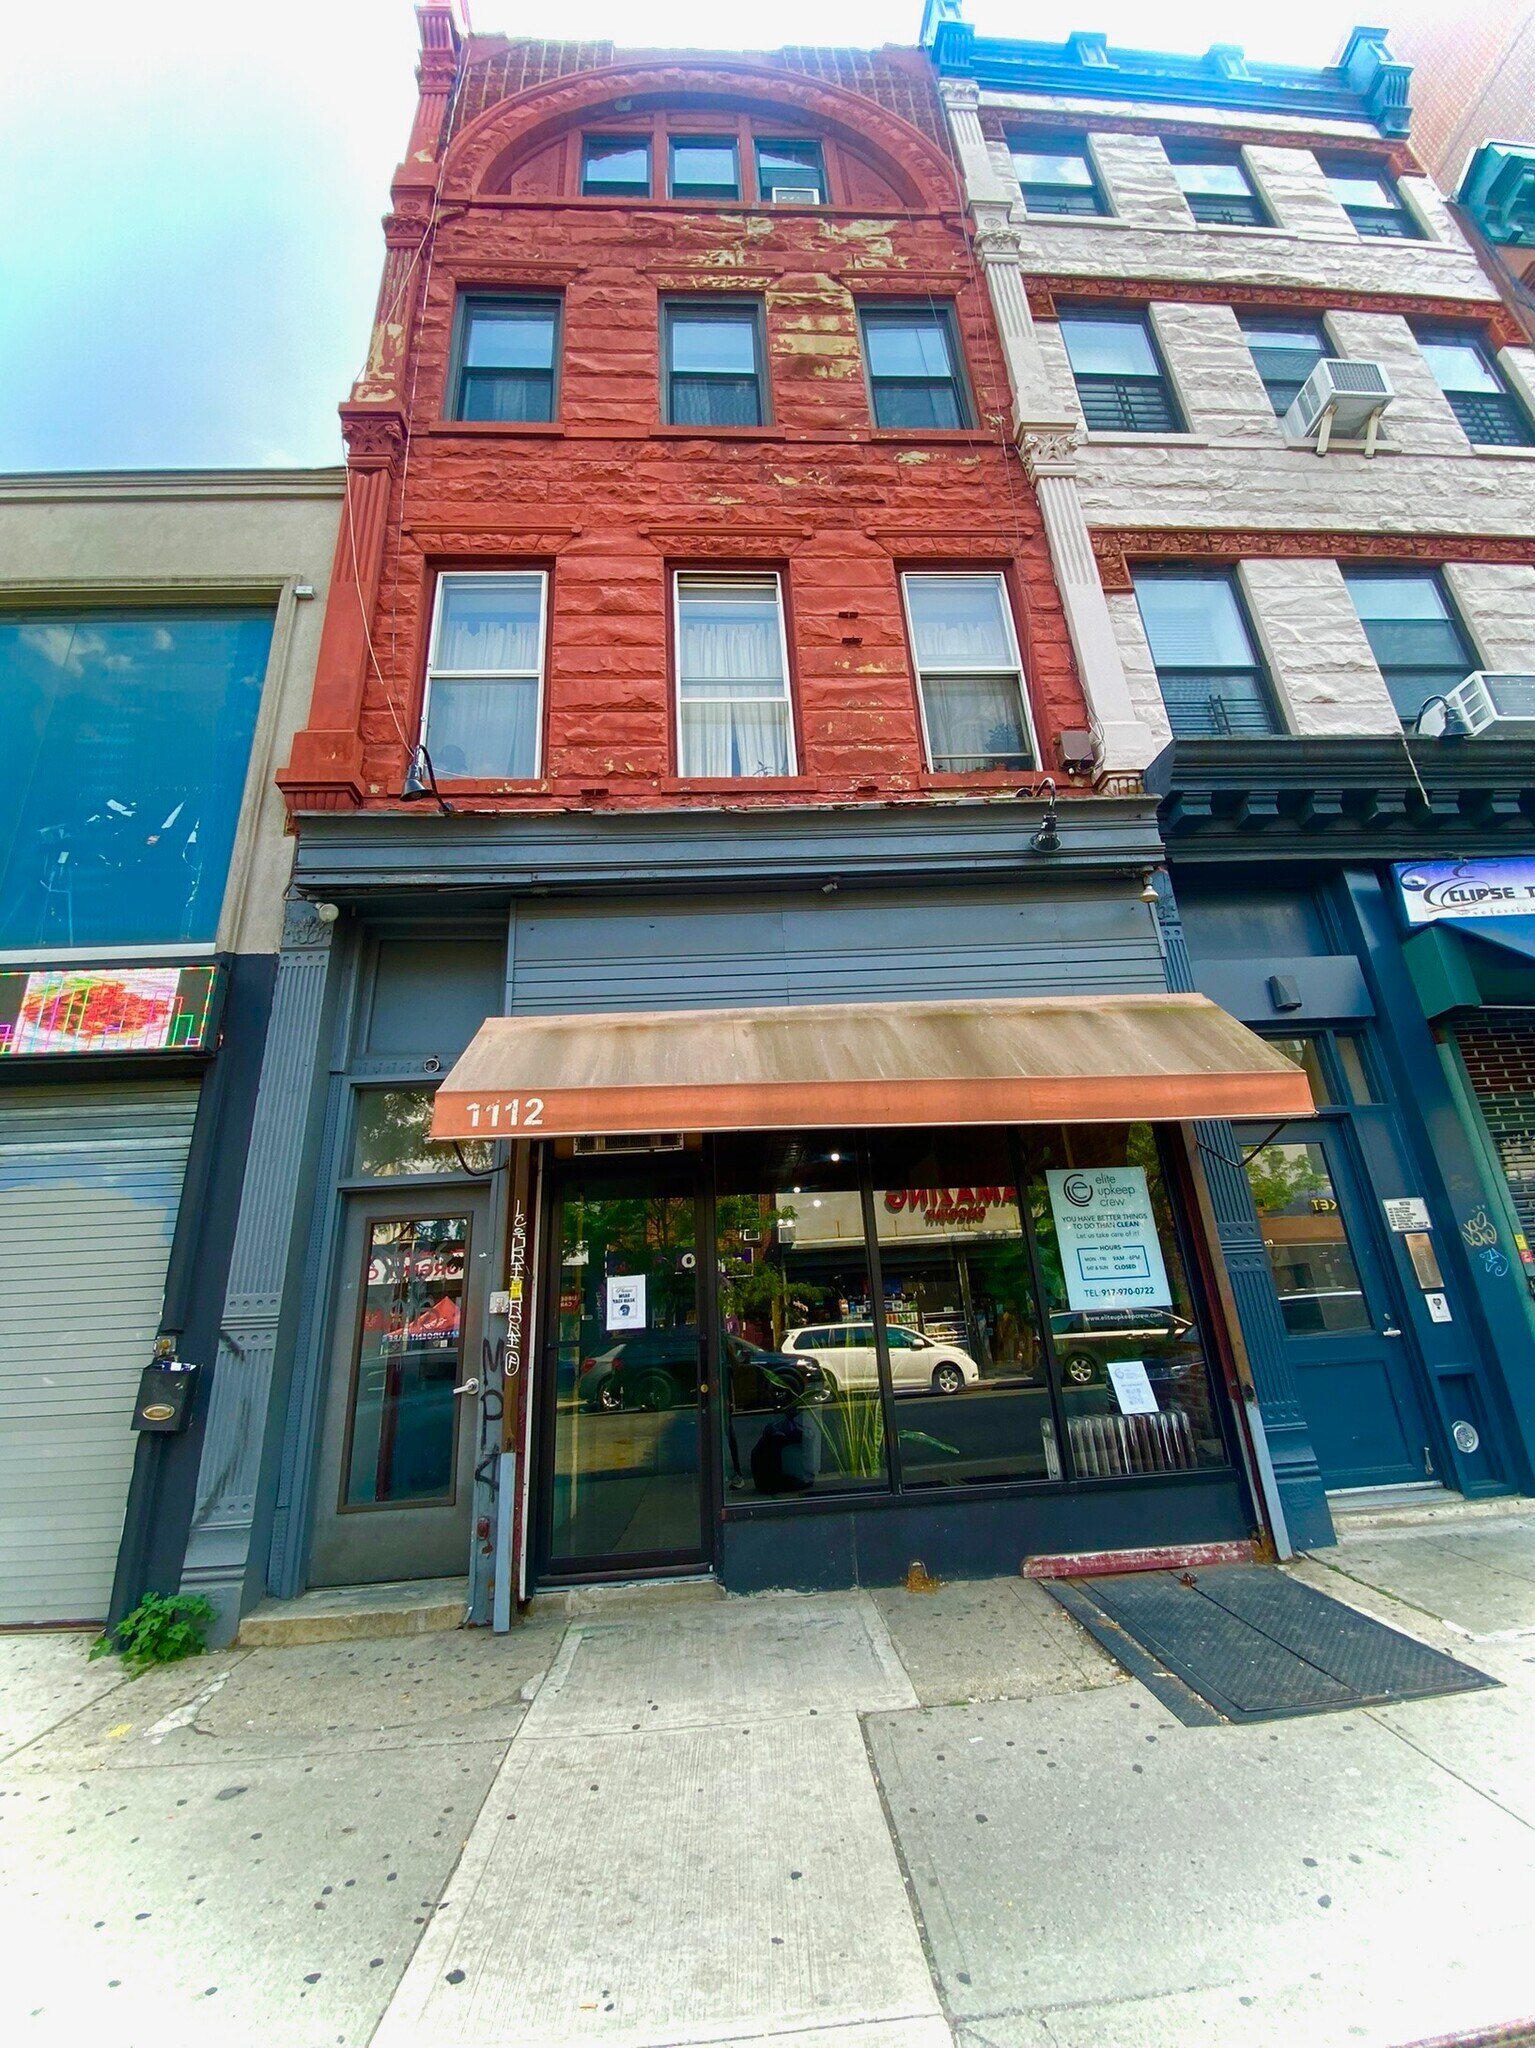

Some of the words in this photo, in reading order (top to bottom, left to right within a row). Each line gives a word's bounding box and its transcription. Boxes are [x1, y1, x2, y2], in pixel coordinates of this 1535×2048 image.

[467, 1098, 545, 1128] 1112
[1095, 1172, 1116, 1184] elite
[1097, 1184, 1136, 1197] upkeep
[1100, 1198, 1125, 1207] crew
